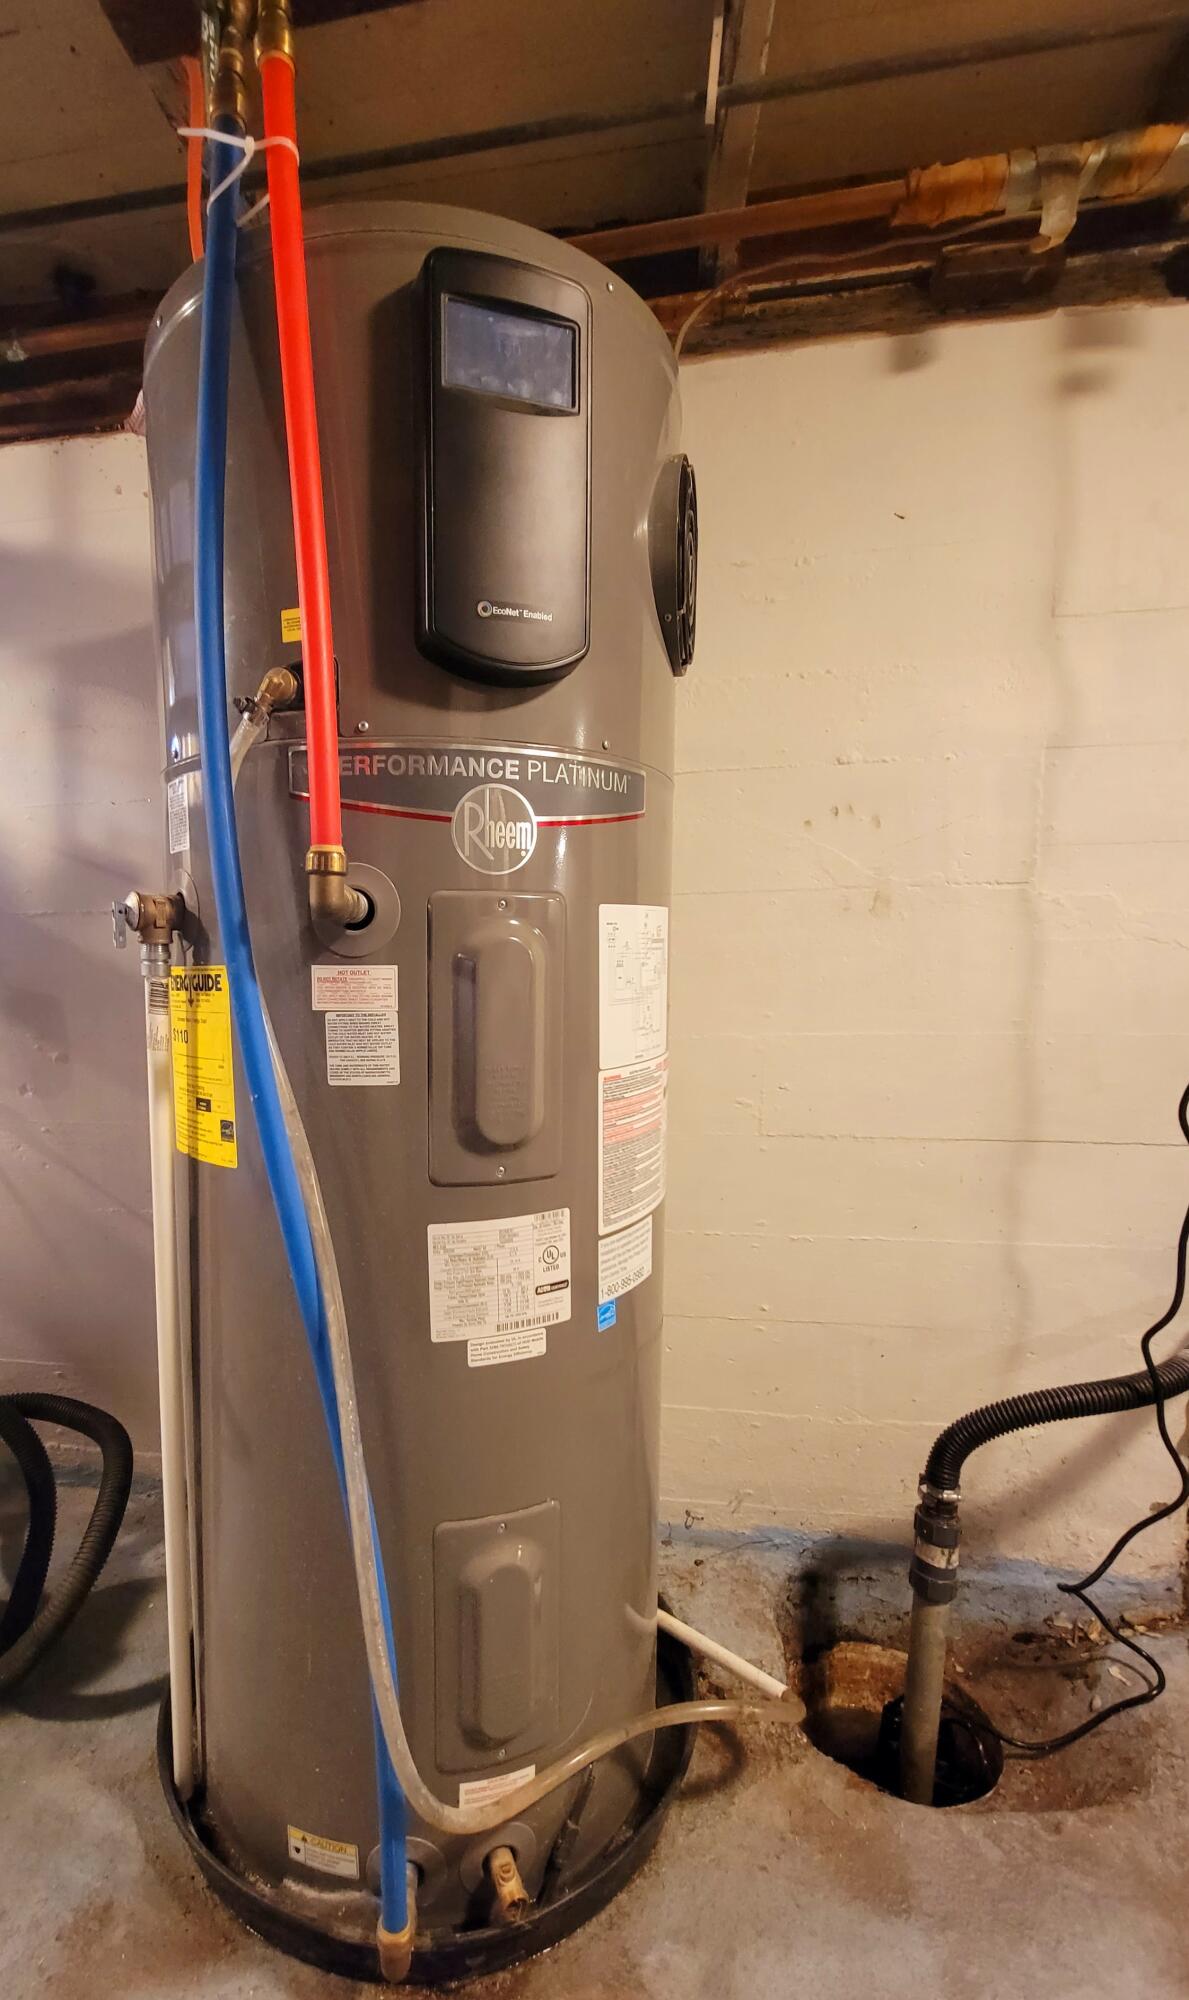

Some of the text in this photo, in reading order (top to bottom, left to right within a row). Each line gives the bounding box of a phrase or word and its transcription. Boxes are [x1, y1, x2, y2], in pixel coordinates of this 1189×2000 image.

[492, 606, 553, 621] EcoNet Enabled
[340, 753, 629, 795] ERFORMANCE PLATINUM
[464, 788, 532, 861] Rheem
